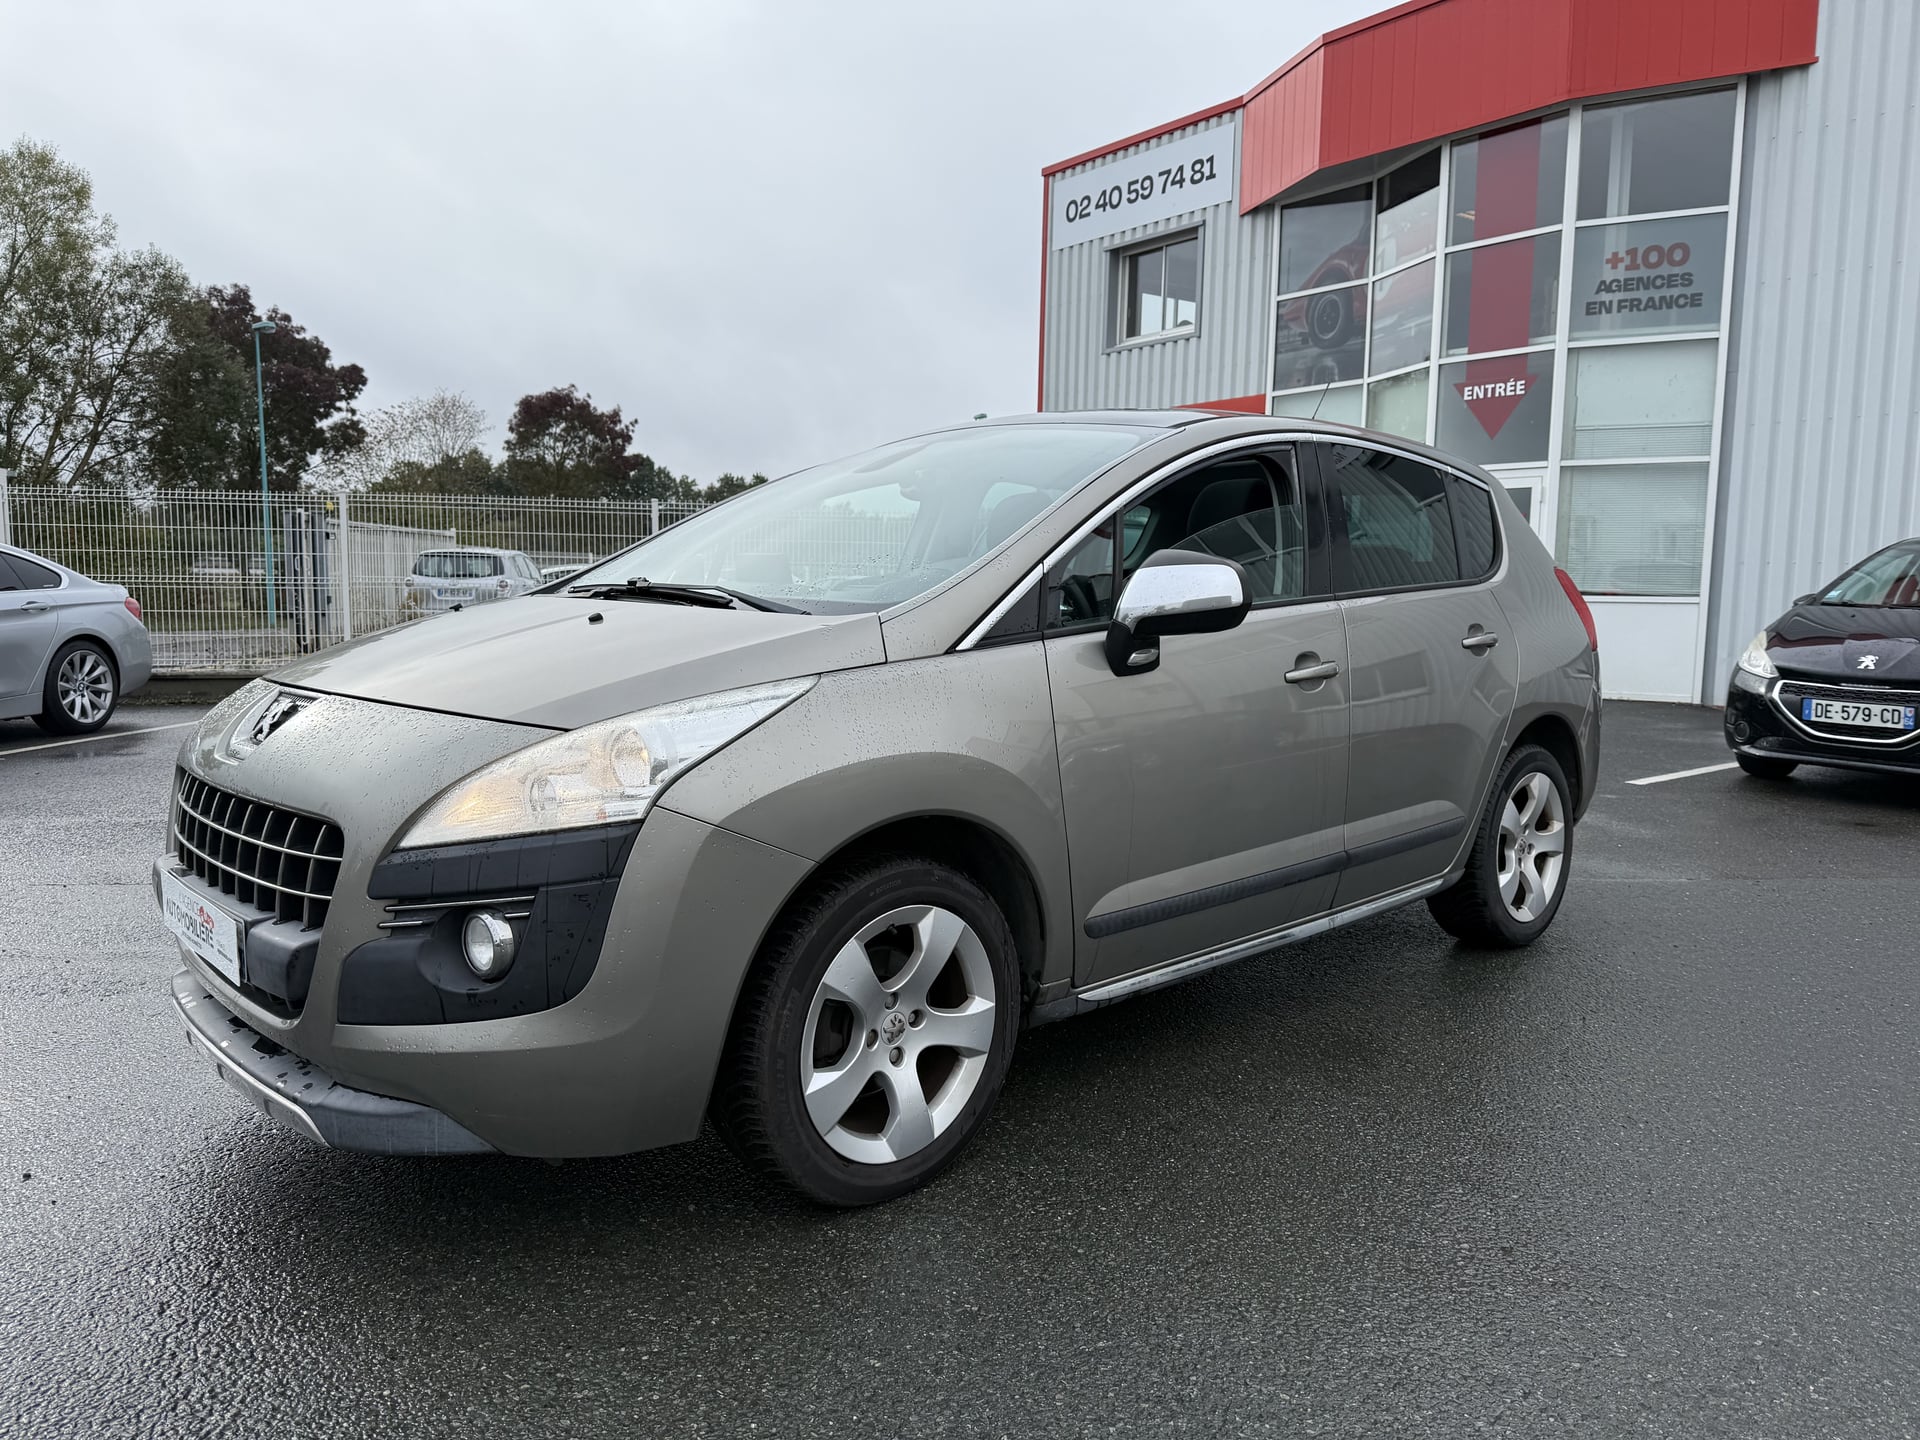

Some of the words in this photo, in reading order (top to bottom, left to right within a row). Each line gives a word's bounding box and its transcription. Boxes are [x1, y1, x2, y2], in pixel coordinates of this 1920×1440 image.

[1065, 195, 1092, 223] 02
[1094, 185, 1123, 212] 40
[1126, 175, 1154, 204] 59
[1158, 164, 1186, 194] 74
[1189, 154, 1217, 185] 81
[1604, 241, 1692, 272] +100
[1594, 271, 1694, 296] AGENCES
[1584, 299, 1614, 317] EN
[1616, 292, 1704, 314] FRANCE
[1463, 378, 1527, 401] ENTRÉE
[1814, 702, 1902, 726] DE-579-CD
